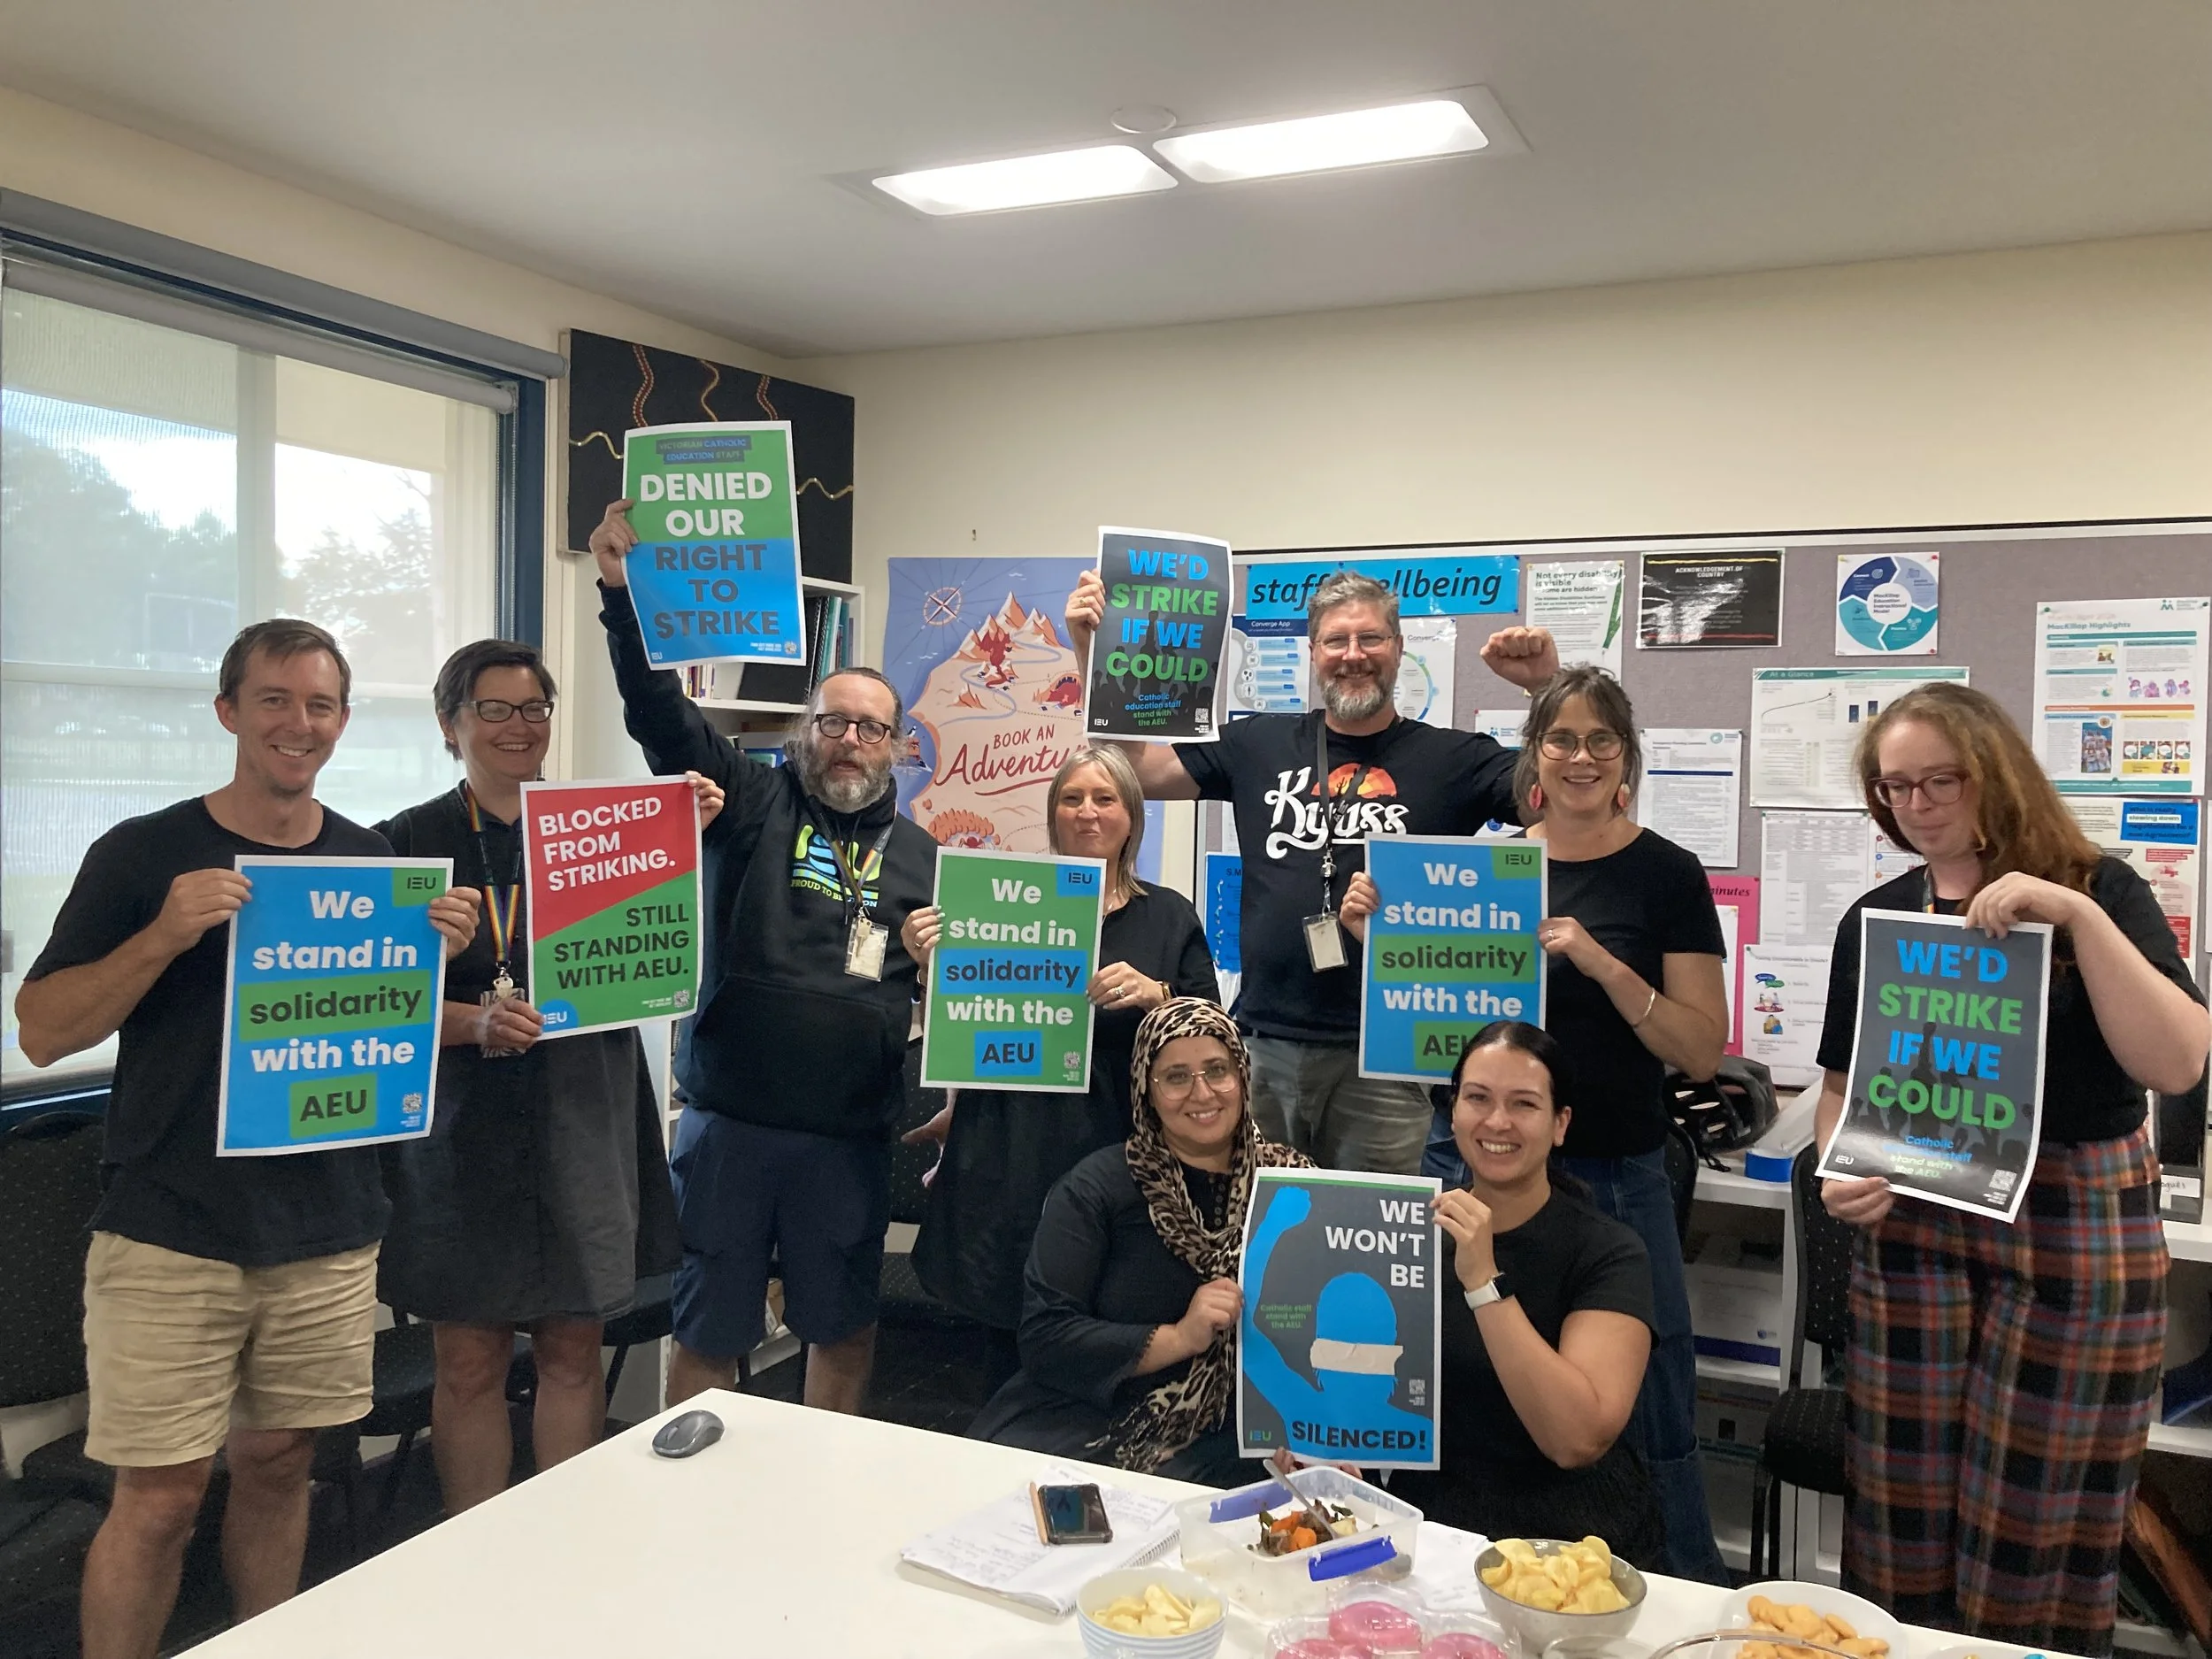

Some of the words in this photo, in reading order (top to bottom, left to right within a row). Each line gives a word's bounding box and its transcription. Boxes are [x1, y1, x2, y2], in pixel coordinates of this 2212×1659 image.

[658, 441, 703, 449] VICTORIAN
[704, 439, 746, 448] CATHOLIC
[717, 450, 741, 459] STAFF
[641, 472, 772, 502] DENIED
[665, 510, 745, 536] OUR
[656, 544, 767, 571] RIGHT
[1129, 549, 1209, 580] WE'D
[688, 580, 738, 603] TO
[1110, 584, 1218, 616] STRIKE
[1377, 567, 1502, 605] ellbeing
[654, 611, 780, 639] STRIKE
[1122, 617, 1149, 643] IF
[1156, 621, 1203, 649] WE
[1106, 652, 1208, 681] COULD
[1125, 702, 1163, 710] education
[993, 728, 1029, 749] BOOK
[1036, 725, 1055, 739] AN
[934, 743, 1087, 787] Adventu
[539, 797, 662, 836] BLOCKED
[543, 832, 620, 864] FROM
[1506, 854, 1532, 864] IEU
[407, 877, 436, 890] IEU
[548, 849, 675, 892] STRIKING.
[1069, 872, 1092, 884] IEU
[1424, 863, 1479, 887] We
[791, 879, 820, 890] PROUD
[822, 887, 832, 897] TO
[991, 878, 1041, 904] We
[1710, 886, 1751, 896] inutes
[310, 890, 374, 919] We
[626, 904, 689, 926] STILL
[1384, 901, 1481, 928] stand
[1489, 902, 1521, 931] in
[554, 930, 689, 962] STANDING
[949, 918, 1040, 944] stand
[1048, 920, 1076, 947] in
[252, 939, 373, 970] stand
[381, 936, 417, 968] in
[1381, 945, 1527, 976] solidarity
[1897, 939, 2008, 982] WE'D
[557, 963, 626, 989] WITH
[634, 956, 688, 980] AEU.
[946, 959, 1081, 988] solidarity
[250, 985, 422, 1025] solidarity
[947, 995, 1015, 1023] with
[1022, 1000, 1073, 1025] the
[1383, 984, 1457, 1013] with
[1464, 989, 1523, 1017] the
[1878, 983, 2023, 1034] STRIKE
[251, 1038, 342, 1072] with
[350, 1037, 415, 1066] the
[981, 1042, 1034, 1064] AEU
[1888, 1030, 1924, 1065] IF
[1932, 1036, 2001, 1080] WE
[300, 1089, 367, 1122] AEU
[1869, 1074, 2016, 1130] COULD
[1905, 1135, 1954, 1149] Catholic
[1835, 1154, 1855, 1166] IEU
[1890, 1154, 1925, 1165] stand
[1927, 1160, 1953, 1171] with
[1916, 1168, 1942, 1179] AEU.
[1379, 1199, 1425, 1225] WE
[1325, 1225, 1425, 1256] WON'T
[1390, 1263, 1425, 1288] BE
[1249, 1430, 1271, 1441] IEU
[1292, 1420, 1425, 1450] SILENCED!
